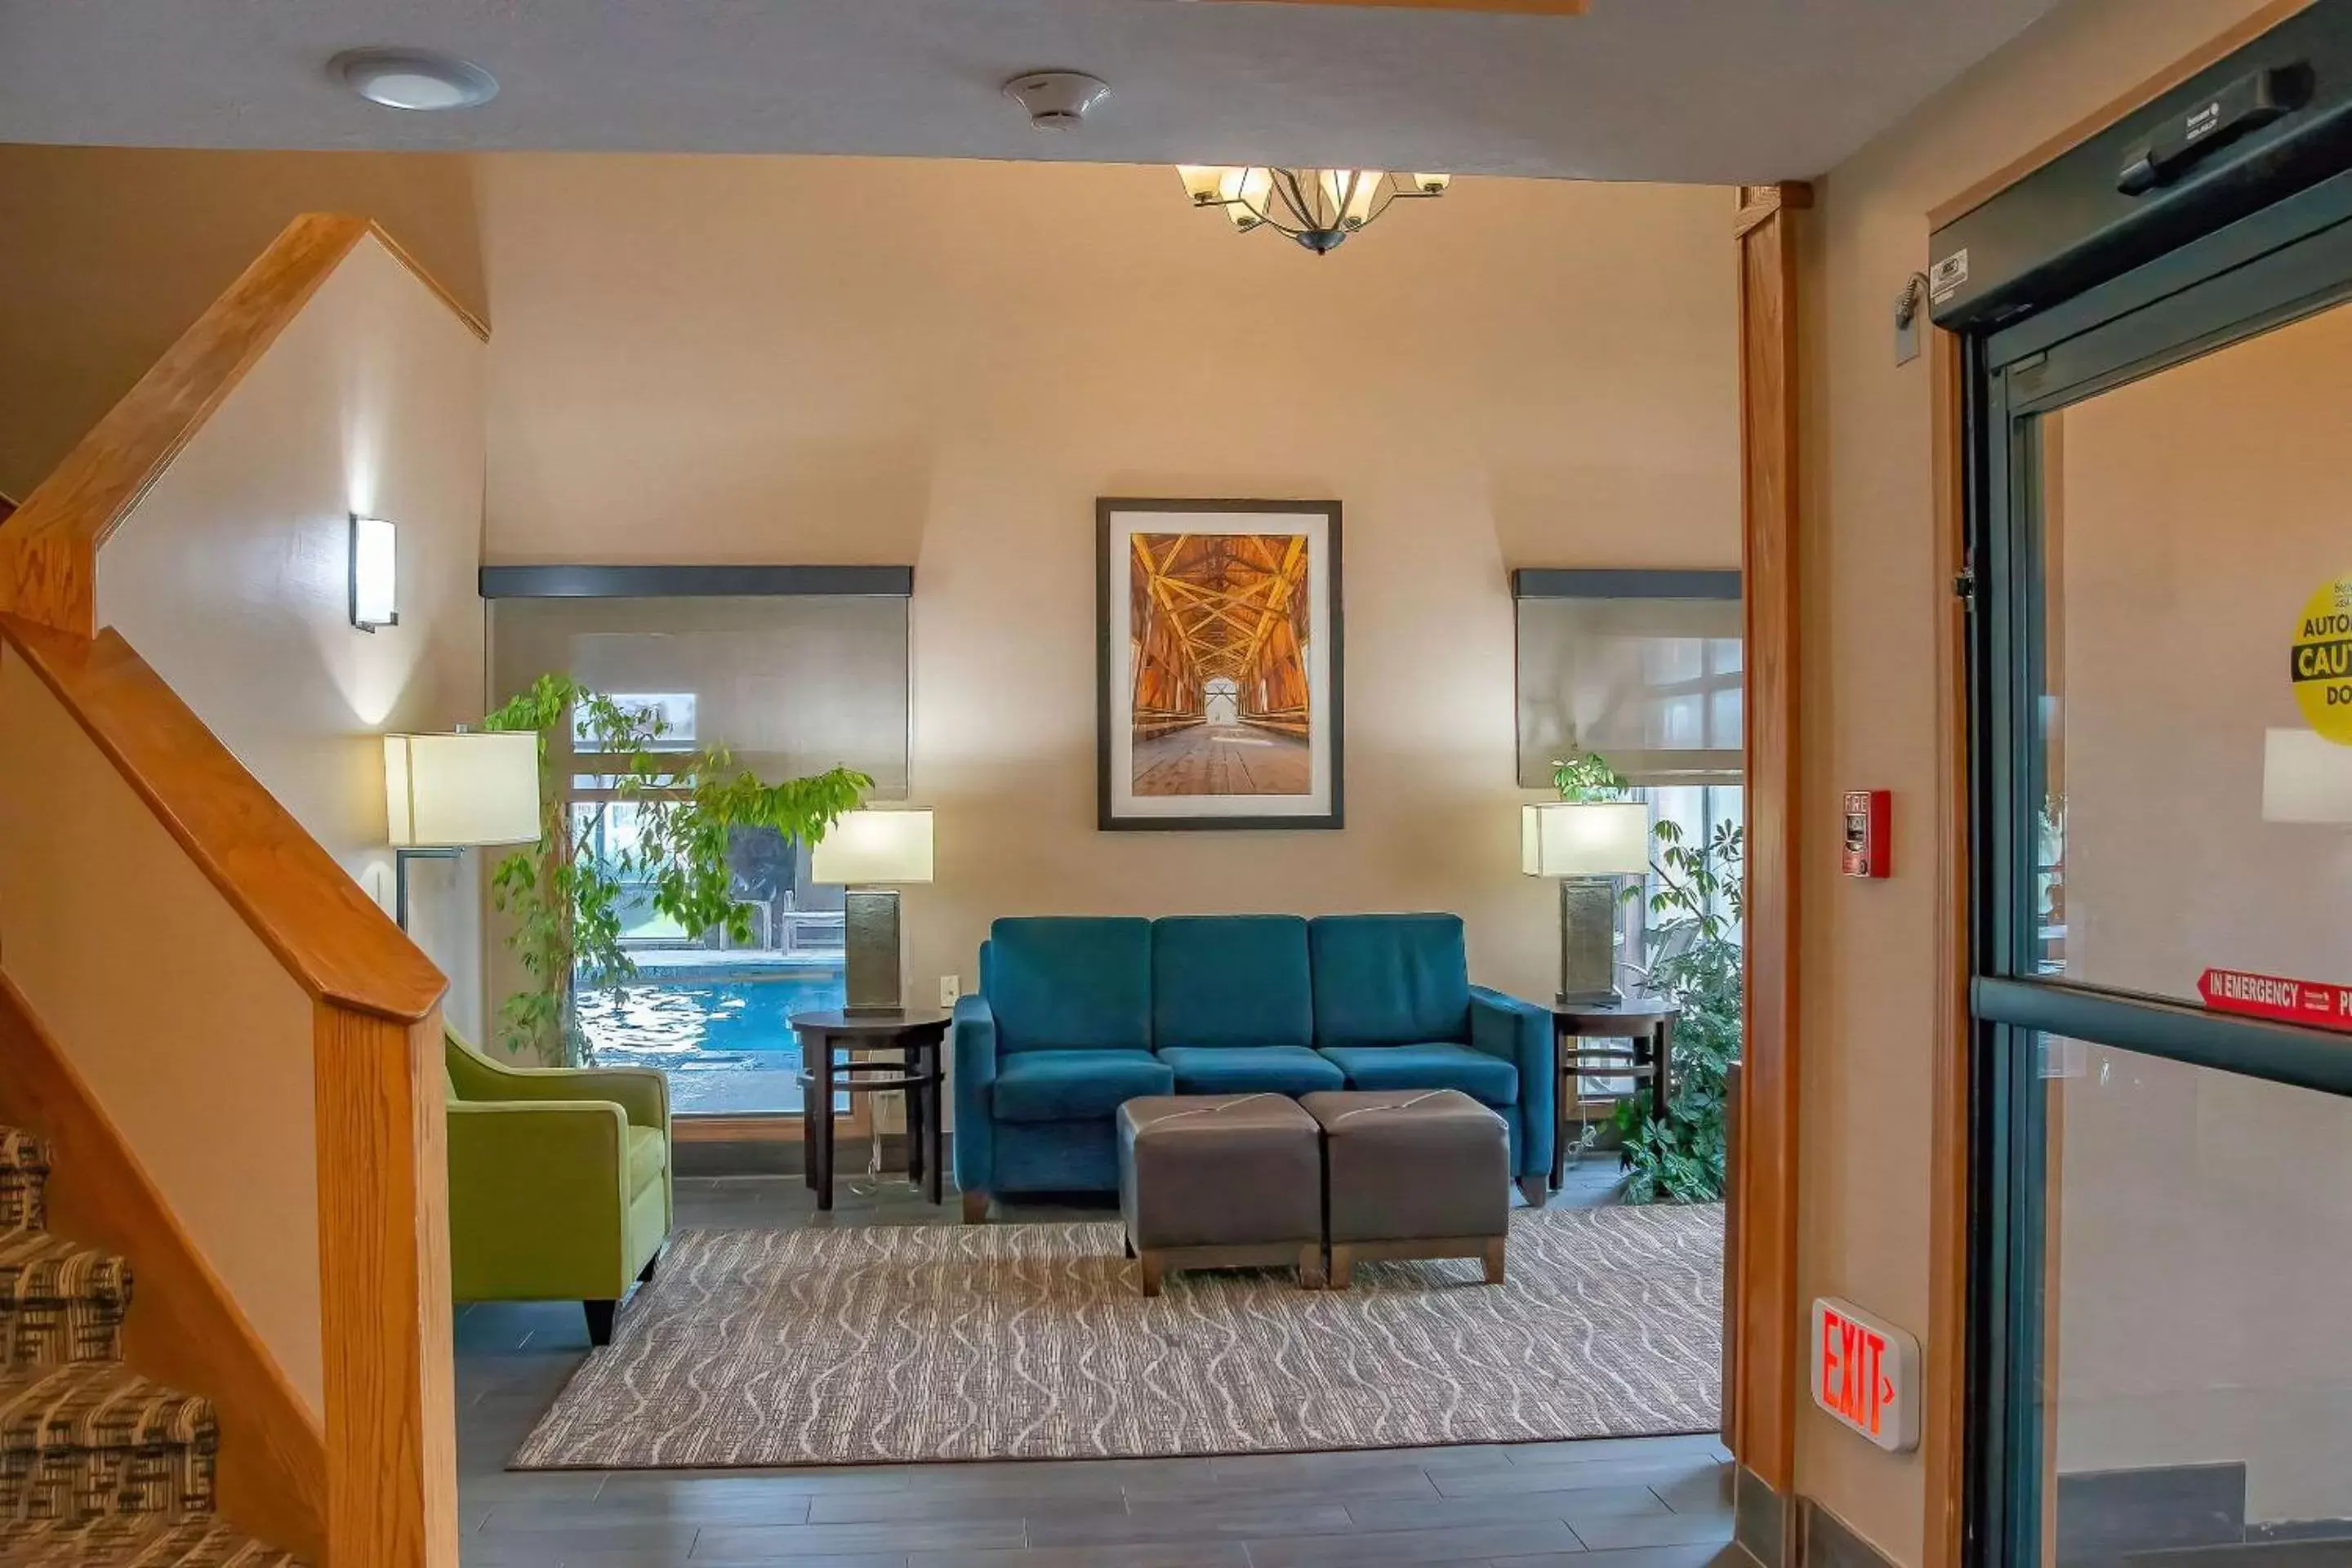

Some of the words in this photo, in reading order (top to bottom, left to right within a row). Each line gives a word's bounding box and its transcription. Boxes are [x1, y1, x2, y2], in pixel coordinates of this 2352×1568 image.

[2303, 613, 2352, 637] AUTO
[1845, 794, 1869, 813] FIRE
[2210, 972, 2222, 996] IN
[2224, 973, 2299, 1009] EMERGENCY
[1822, 1309, 1885, 1437] EXIT
